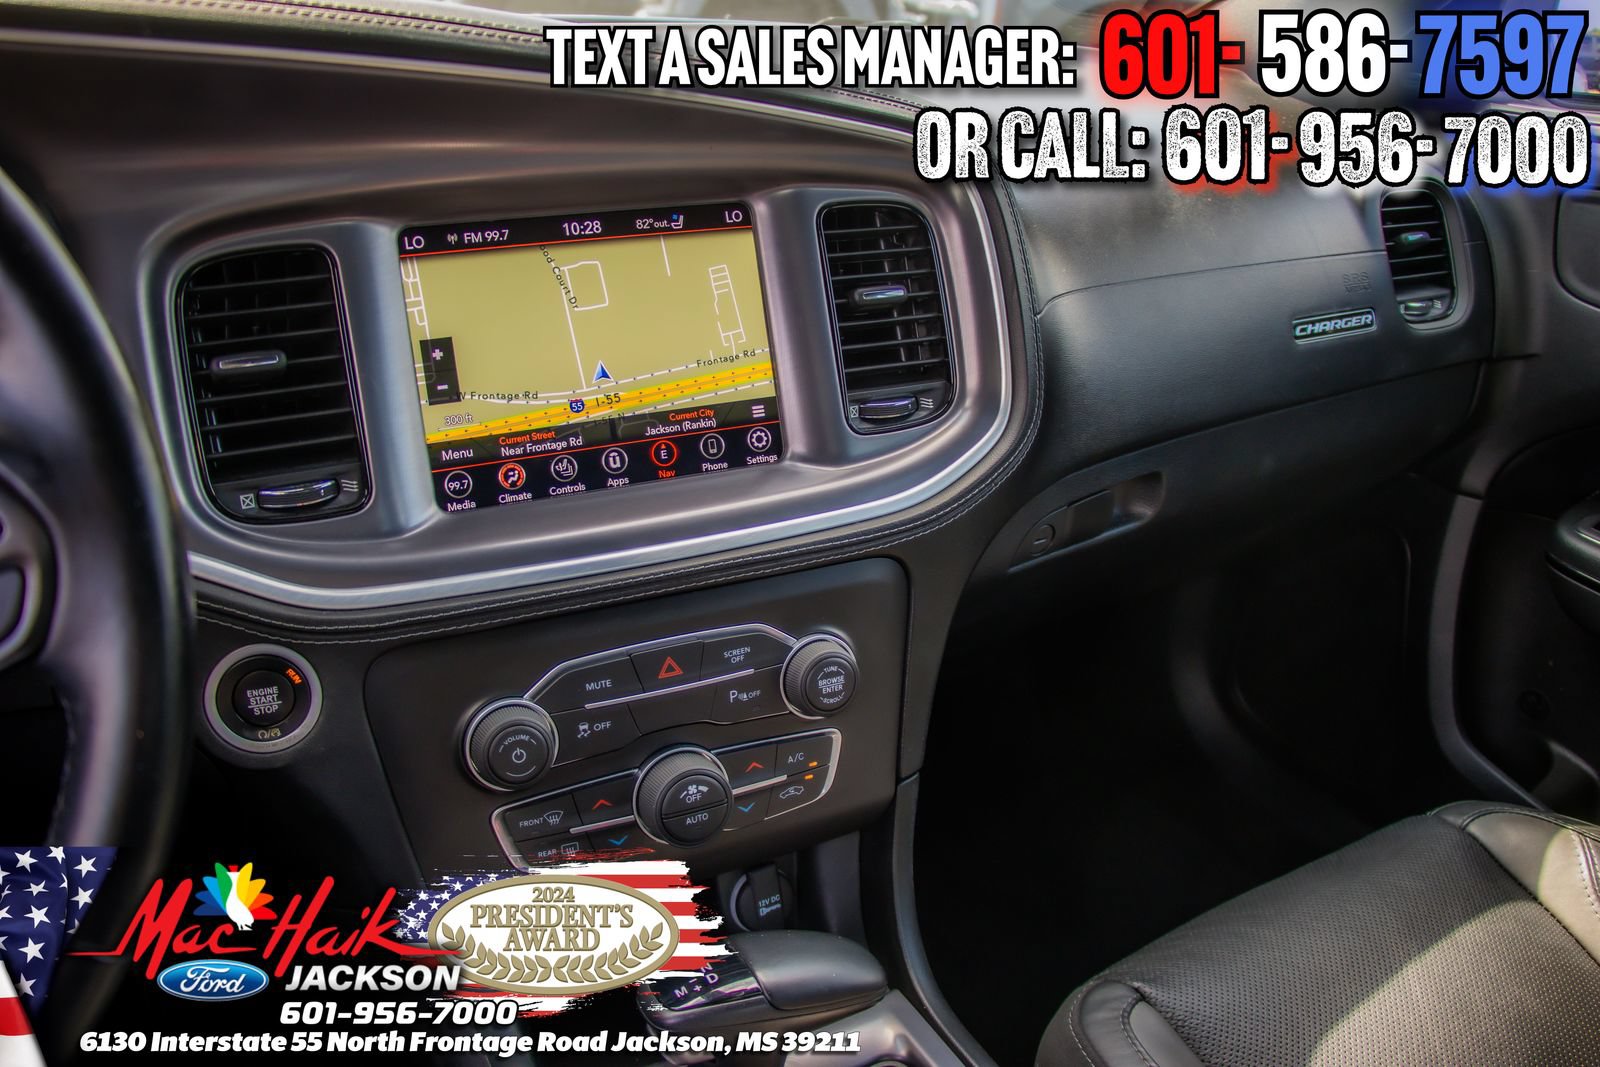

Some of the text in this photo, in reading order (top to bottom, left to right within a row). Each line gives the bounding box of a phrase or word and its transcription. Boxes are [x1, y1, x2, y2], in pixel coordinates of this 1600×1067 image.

[725, 210, 743, 223] LO
[562, 220, 602, 236] 10:28
[404, 235, 425, 250] LO
[463, 229, 509, 244] FM 99.7
[552, 266, 571, 296] Court
[569, 296, 579, 310] Dr
[1295, 314, 1373, 337] CHARGER
[696, 349, 756, 368] Frontage Rd
[470, 391, 520, 403] Frontage
[524, 391, 538, 399] Rd
[572, 402, 583, 411] 55
[444, 413, 474, 426] 300 ft
[669, 409, 715, 421] Current City
[645, 419, 717, 437] Jackson (Rankin)
[499, 431, 556, 445] Current Street
[501, 436, 583, 457] Near Frontage Rd
[441, 448, 474, 461] Menu
[746, 454, 778, 465] Settings
[702, 461, 729, 472] Phone
[658, 469, 676, 479] Nav
[448, 479, 469, 491] 99.7
[607, 476, 630, 488] Apps
[549, 483, 586, 496] Controls
[498, 491, 533, 504] Climate
[447, 500, 477, 512] Media
[723, 647, 751, 658] SCREEN
[730, 655, 745, 664] OFF
[286, 668, 302, 684] RUN
[823, 666, 838, 674] TUNE
[585, 679, 612, 691] MUTE
[818, 675, 845, 686] BROWSE
[247, 686, 279, 698] ENGINE
[748, 690, 761, 699] OFF
[822, 684, 843, 694] ENTER
[249, 694, 279, 706] START
[822, 696, 843, 704] SCROLL
[254, 704, 279, 716] STOP
[593, 721, 612, 732] OFF
[503, 734, 530, 746] VOLUME
[787, 752, 805, 764] A/C
[686, 792, 702, 804] OFF
[519, 817, 544, 828] FRONT
[686, 812, 709, 825] AUTO
[538, 848, 557, 858] REAR
[758, 897, 770, 907] 12V
[705, 973, 719, 984] D
[673, 985, 688, 998] M
